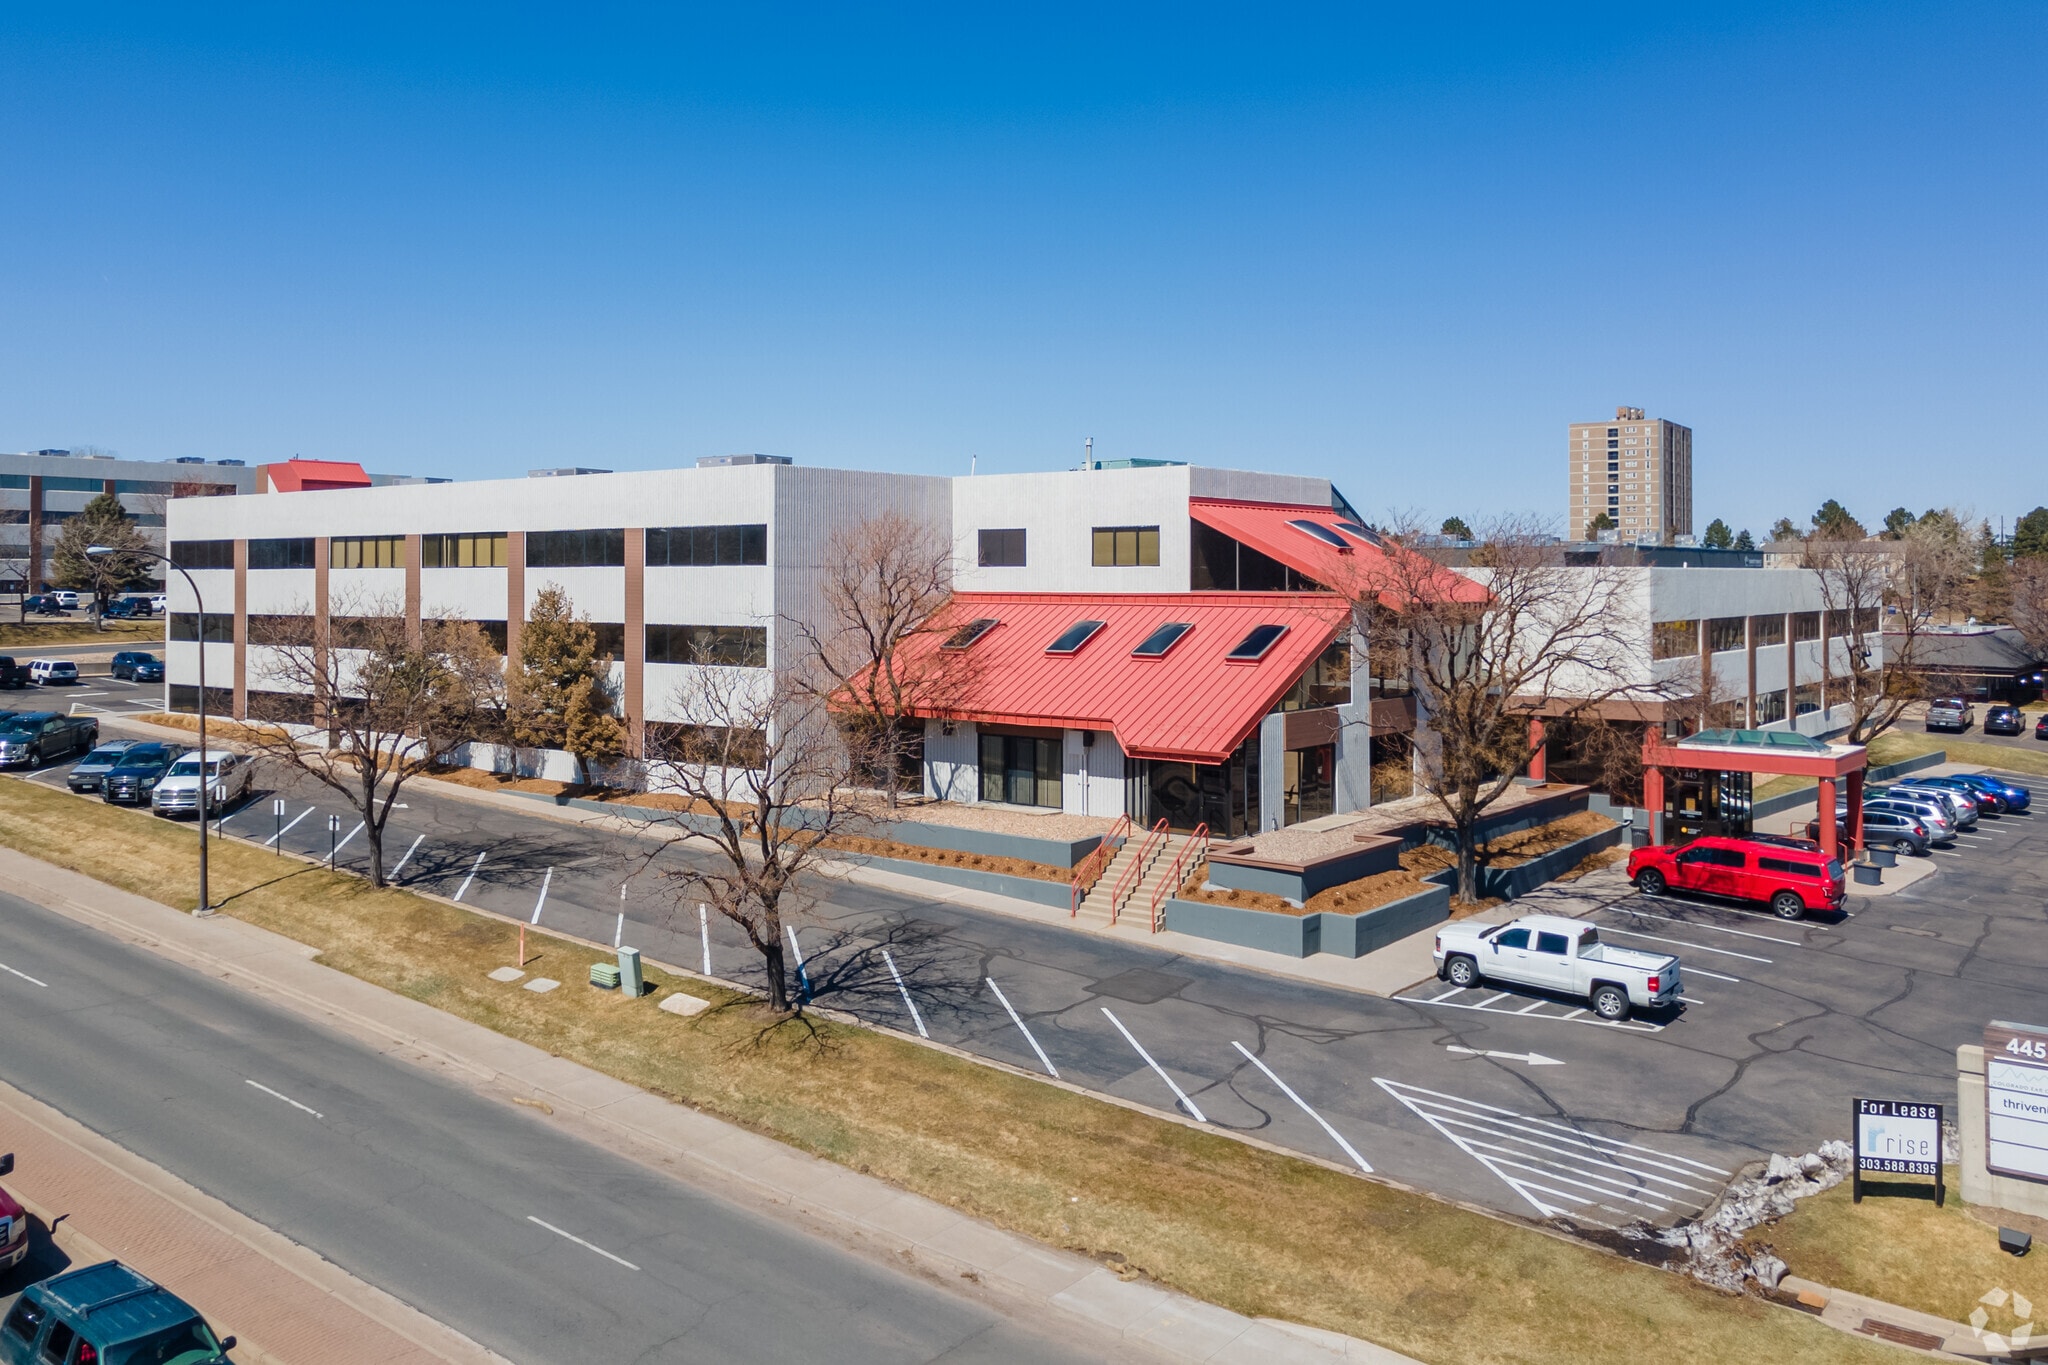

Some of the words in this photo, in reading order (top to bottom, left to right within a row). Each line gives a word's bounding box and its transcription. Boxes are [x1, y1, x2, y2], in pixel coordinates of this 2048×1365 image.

[2006, 1038, 2047, 1059] 445
[1861, 1100, 1885, 1114] For
[1892, 1102, 1936, 1118] Lease
[2003, 1098, 2048, 1114] thriven
[1886, 1133, 1928, 1156] rise
[1860, 1158, 1937, 1174] 303.588.8395
